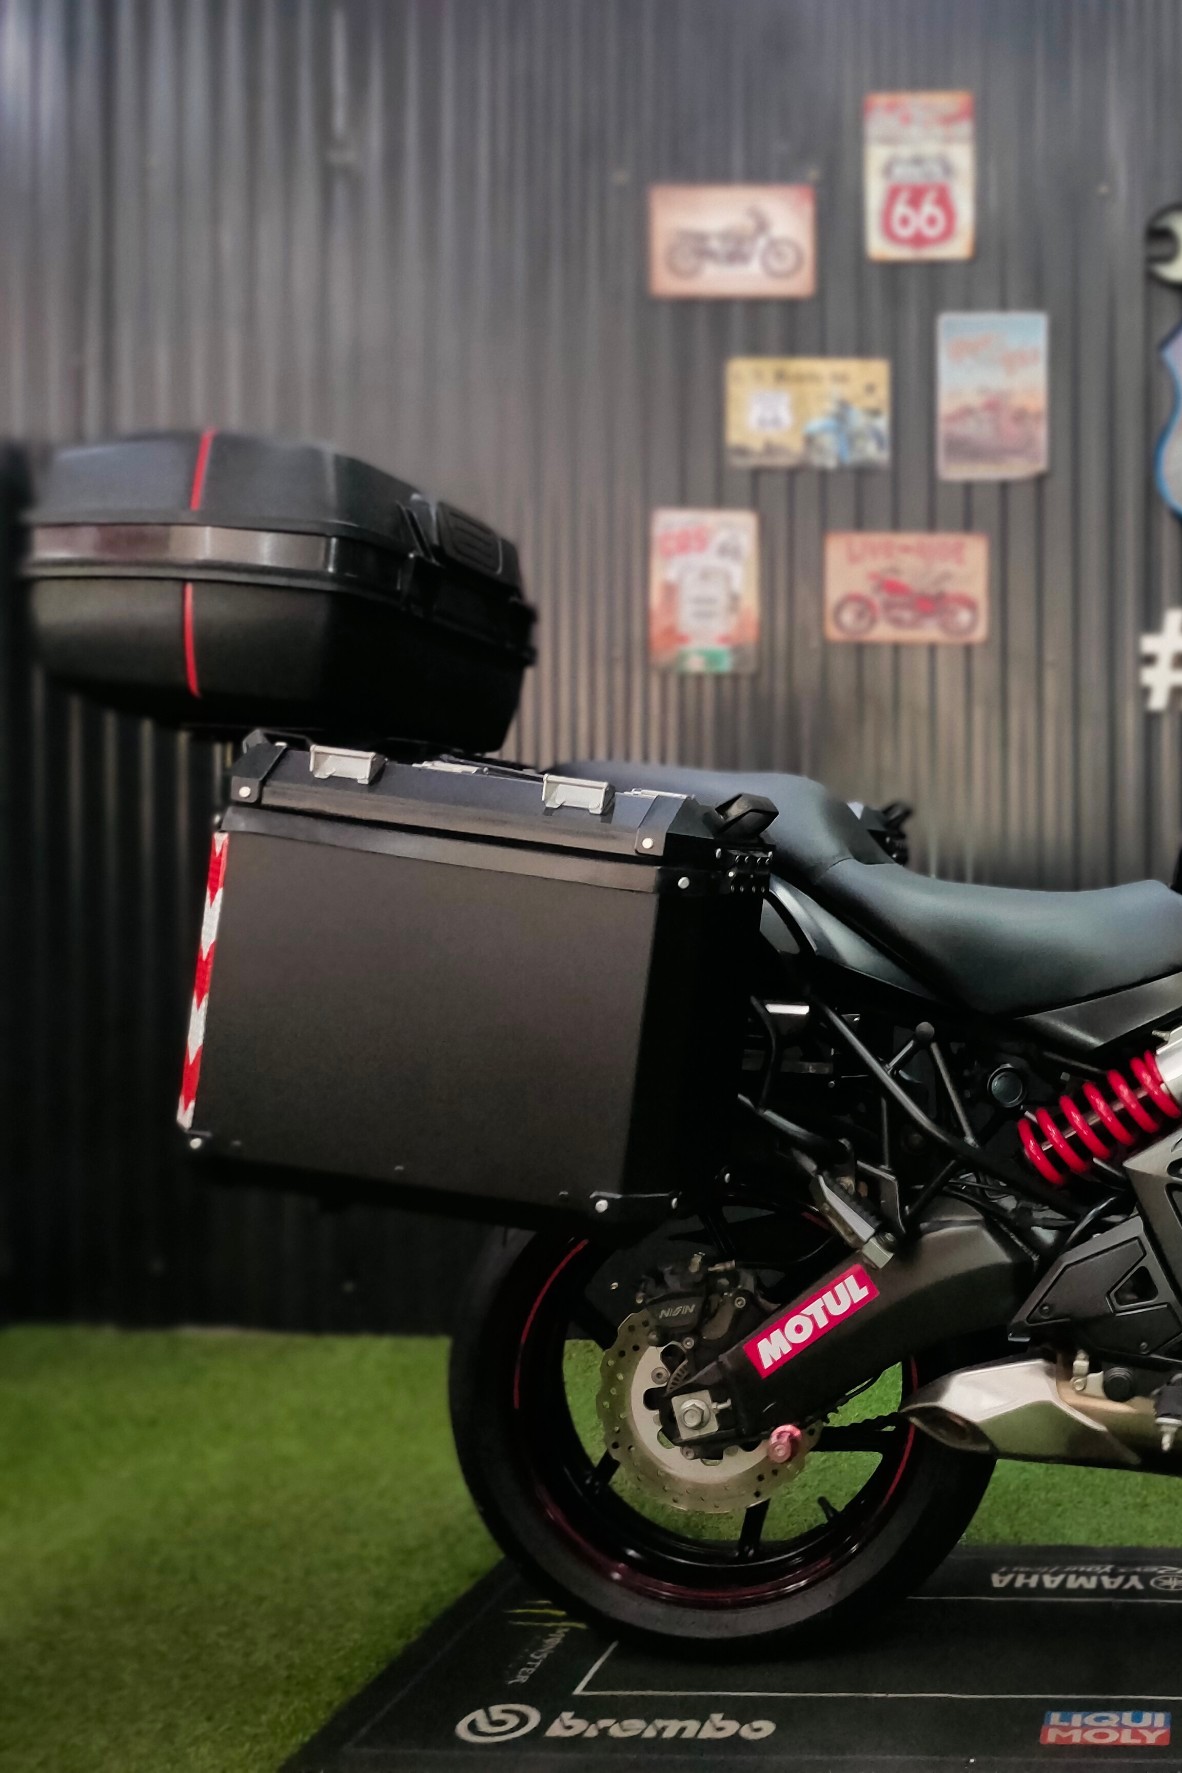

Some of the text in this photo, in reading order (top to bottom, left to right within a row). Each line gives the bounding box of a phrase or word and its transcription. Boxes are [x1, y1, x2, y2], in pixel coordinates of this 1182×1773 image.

[892, 188, 947, 238] 66
[757, 1275, 869, 1370] MOTUL
[991, 1573, 1144, 1589] YAMAHA
[544, 1711, 777, 1740] brembo
[1050, 1712, 1165, 1727] LIQUI
[1047, 1728, 1167, 1743] MOLY
